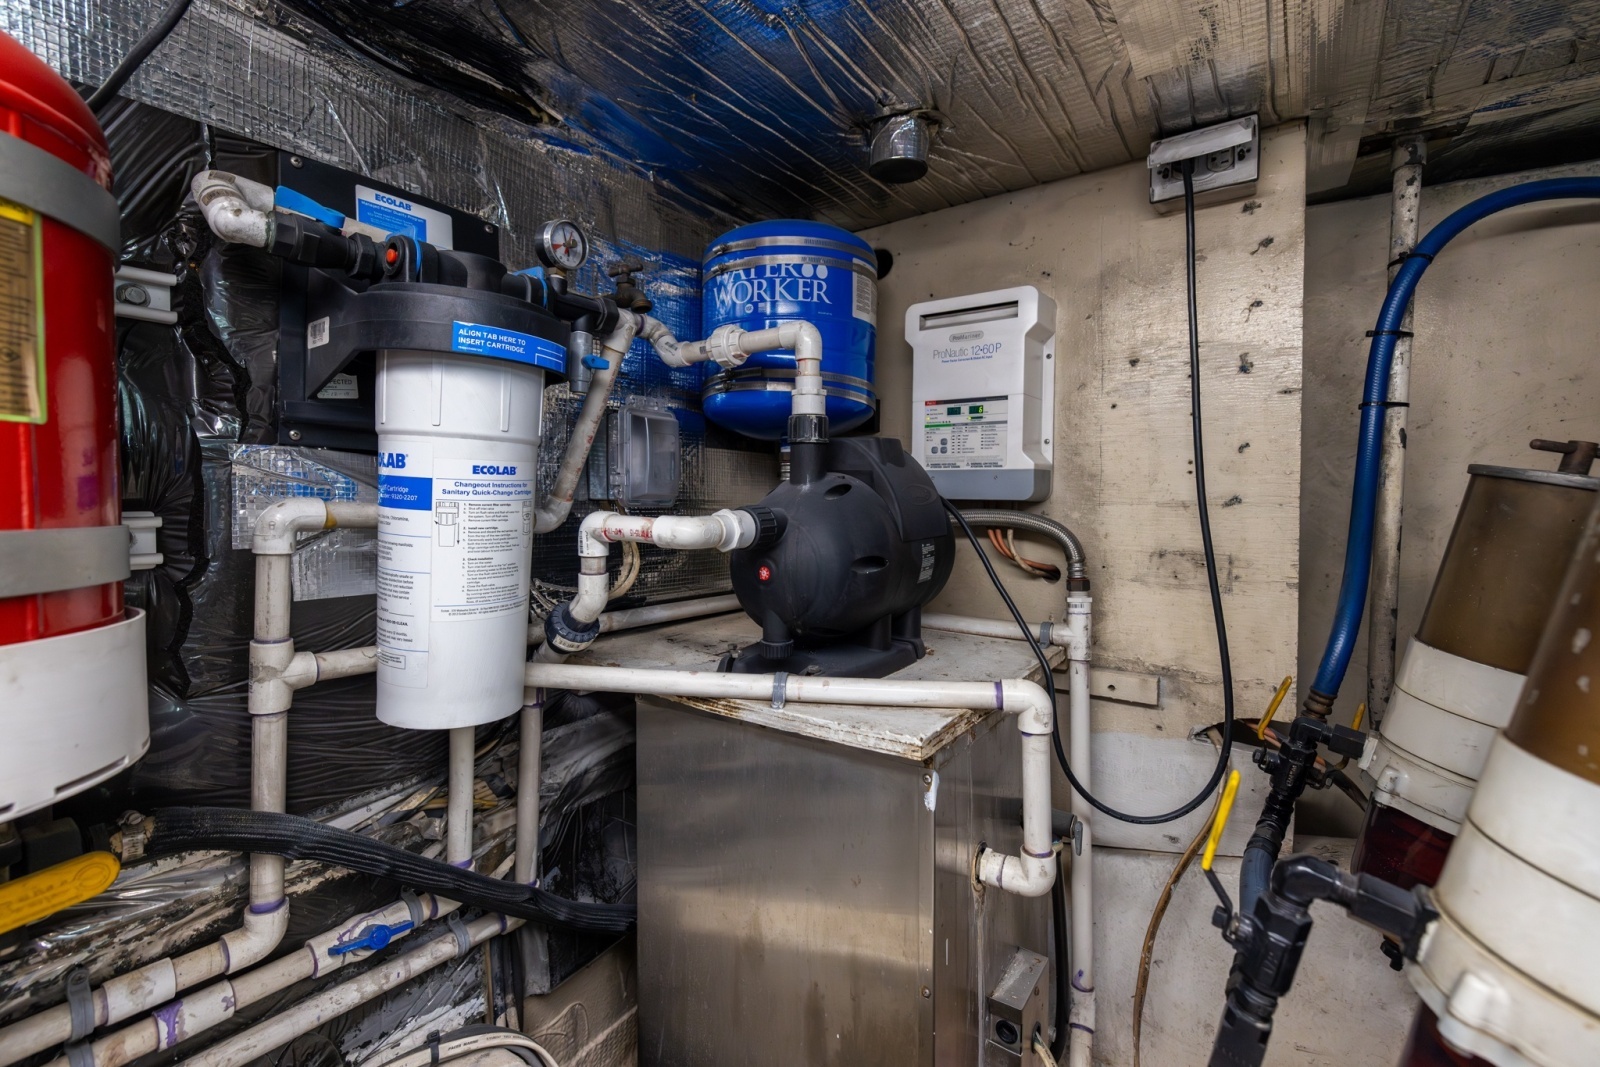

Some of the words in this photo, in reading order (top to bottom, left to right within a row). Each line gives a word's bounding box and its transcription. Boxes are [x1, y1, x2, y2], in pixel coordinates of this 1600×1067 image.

[374, 193, 412, 212] ECOLAB
[713, 278, 833, 309] WORKER
[458, 329, 482, 337] ALIGN
[483, 332, 498, 340] TAB
[498, 334, 517, 344] HERE
[518, 338, 526, 346] TO
[458, 337, 485, 347] INSERT
[486, 341, 526, 354] CARTRIDGE.
[932, 348, 969, 360] ProNautic
[472, 465, 517, 475] ECOLAB
[387, 485, 409, 493] Cartridge
[454, 481, 491, 489] Changeout
[441, 488, 471, 496] Sanitary
